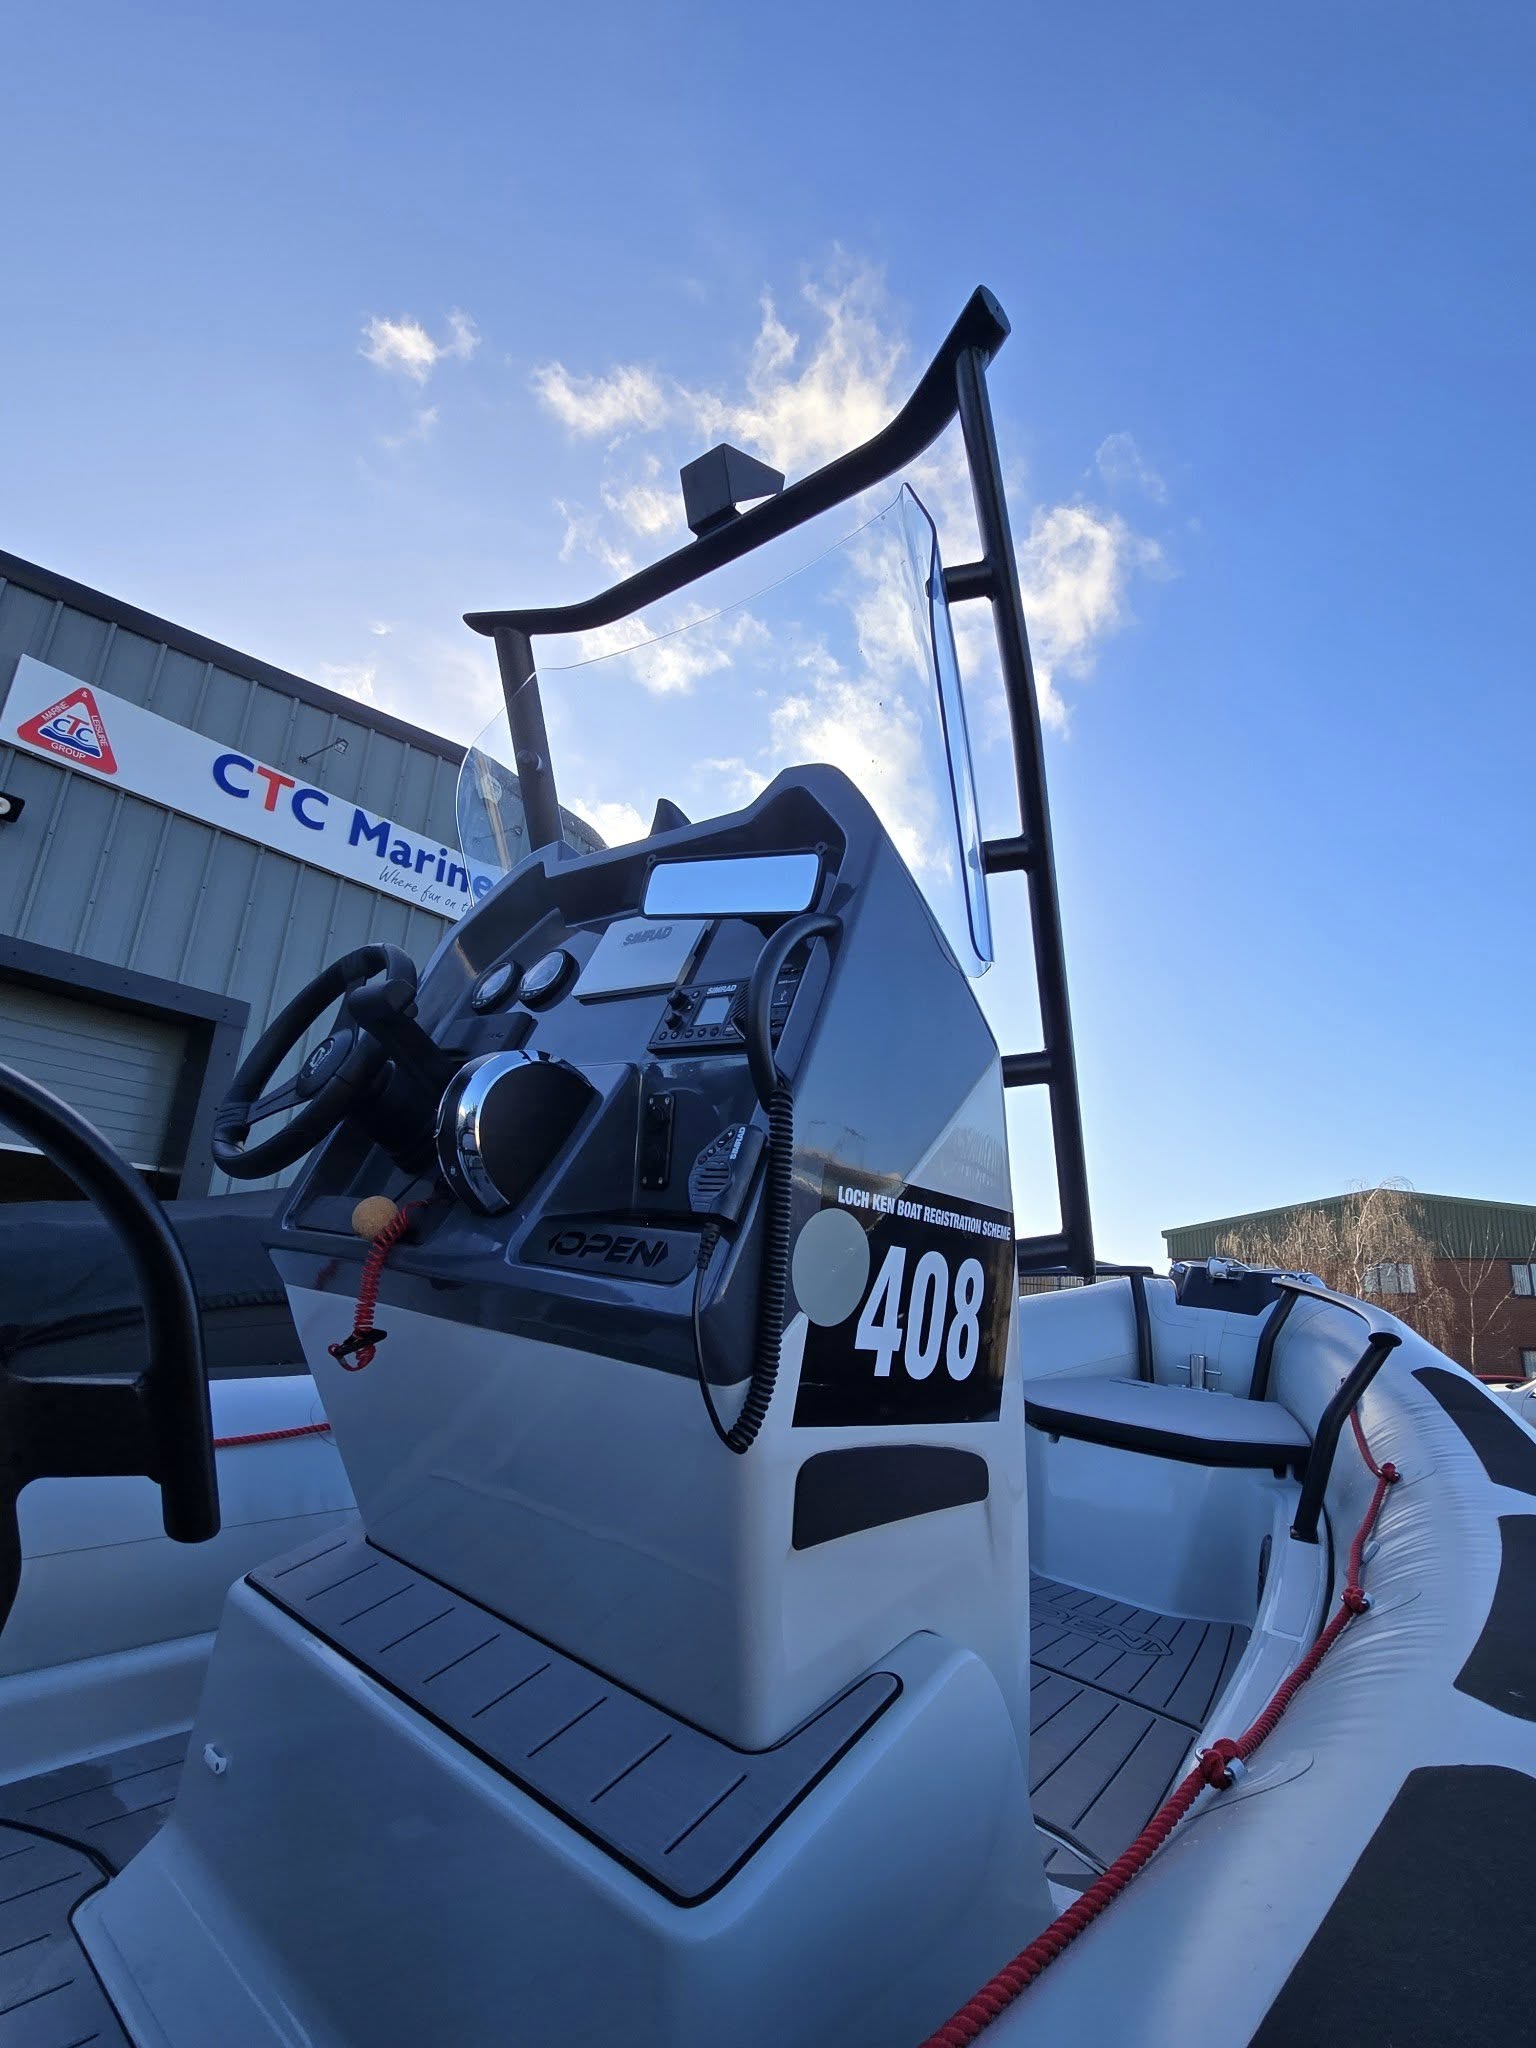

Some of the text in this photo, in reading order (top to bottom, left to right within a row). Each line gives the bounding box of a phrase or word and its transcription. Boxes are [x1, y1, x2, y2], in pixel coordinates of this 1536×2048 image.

[41, 701, 70, 721] MARINE
[91, 715, 108, 747] LEISURE
[52, 714, 94, 743] CTC
[51, 742, 86, 759] GROUP
[212, 753, 494, 900] CTC Marine
[379, 865, 418, 893] Where
[420, 885, 441, 902] fun
[444, 898, 457, 910] on
[623, 926, 673, 946] SIMRAD
[706, 985, 737, 994] SIMRAD
[730, 1126, 746, 1160] SIMRAD
[838, 1185, 1012, 1241] LOCH KEN BOAT REGISTRATION SCHEME
[554, 1231, 666, 1267] OPEN
[855, 1245, 985, 1381] 408
